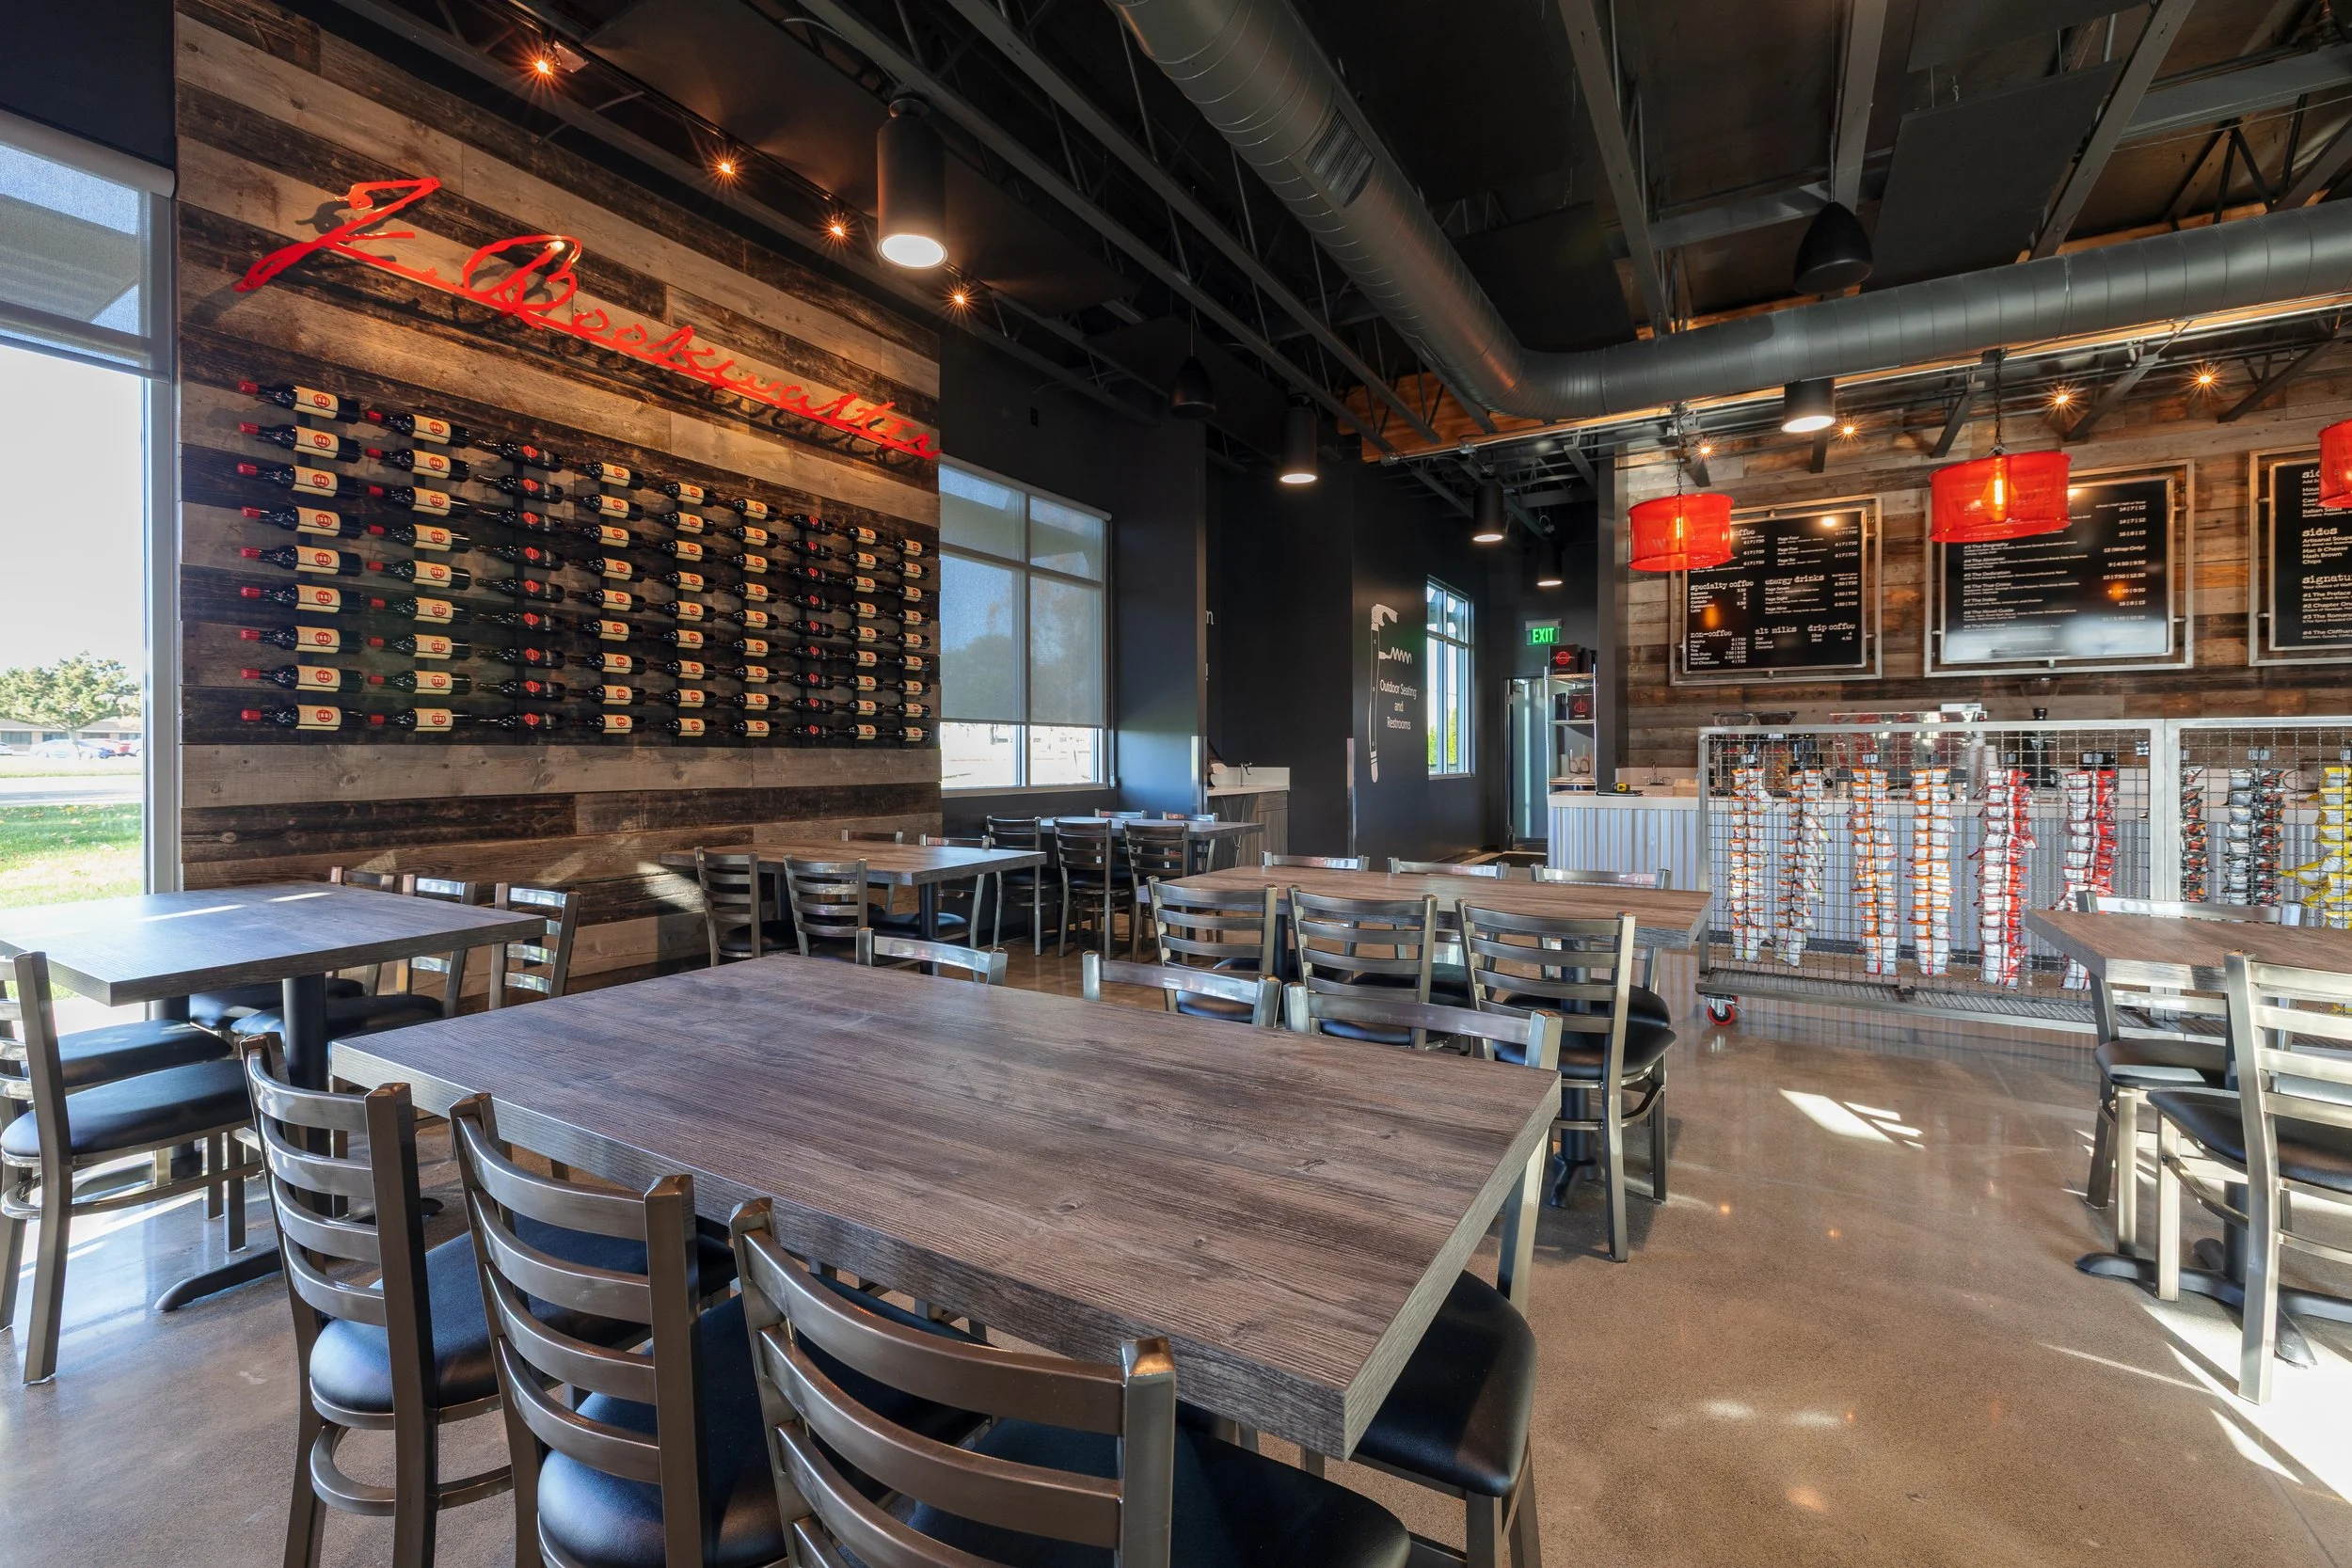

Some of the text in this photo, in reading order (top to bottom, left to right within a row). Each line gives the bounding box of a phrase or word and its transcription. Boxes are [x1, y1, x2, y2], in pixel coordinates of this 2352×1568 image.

[2302, 527, 2338, 537] sides
[1794, 575, 1825, 584] drinks
[2302, 574, 2352, 585] signatu
[1690, 579, 1754, 592] specialty coffee
[1771, 626, 1798, 634] milks
[1807, 622, 1856, 633] drip coffee
[1533, 627, 1554, 643] EXIT
[1690, 629, 1733, 638] non-coffee
[1380, 679, 1417, 700] Outdoor Seating
[1394, 700, 1404, 712] and
[1387, 716, 1411, 730] Restrooms
